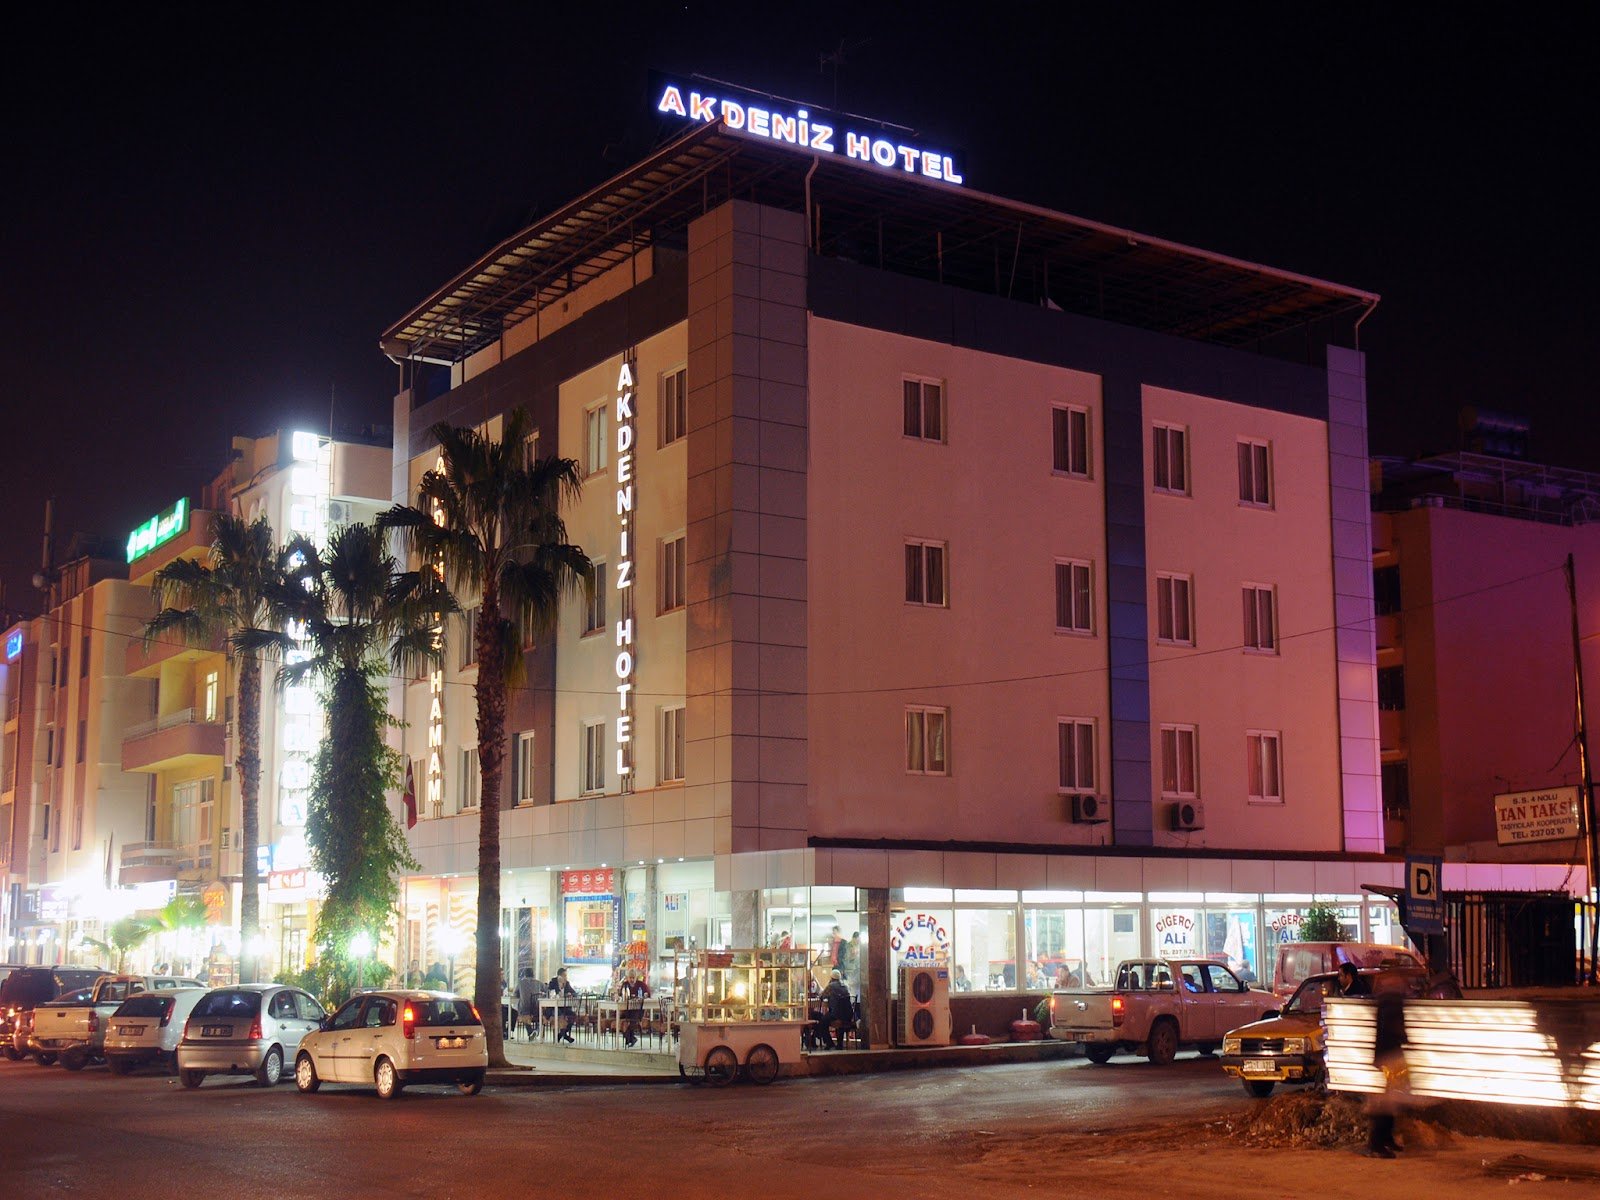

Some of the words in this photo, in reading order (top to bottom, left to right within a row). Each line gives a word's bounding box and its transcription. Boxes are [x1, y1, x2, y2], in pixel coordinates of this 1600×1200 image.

[658, 86, 834, 153] AKDENİZ
[845, 132, 962, 184] HOTEL
[615, 618, 632, 775] HOTEL
[428, 669, 443, 802] HAMAM
[1499, 806, 1527, 821] TAN
[1537, 793, 1558, 802] NOLU
[1416, 868, 1432, 895] D
